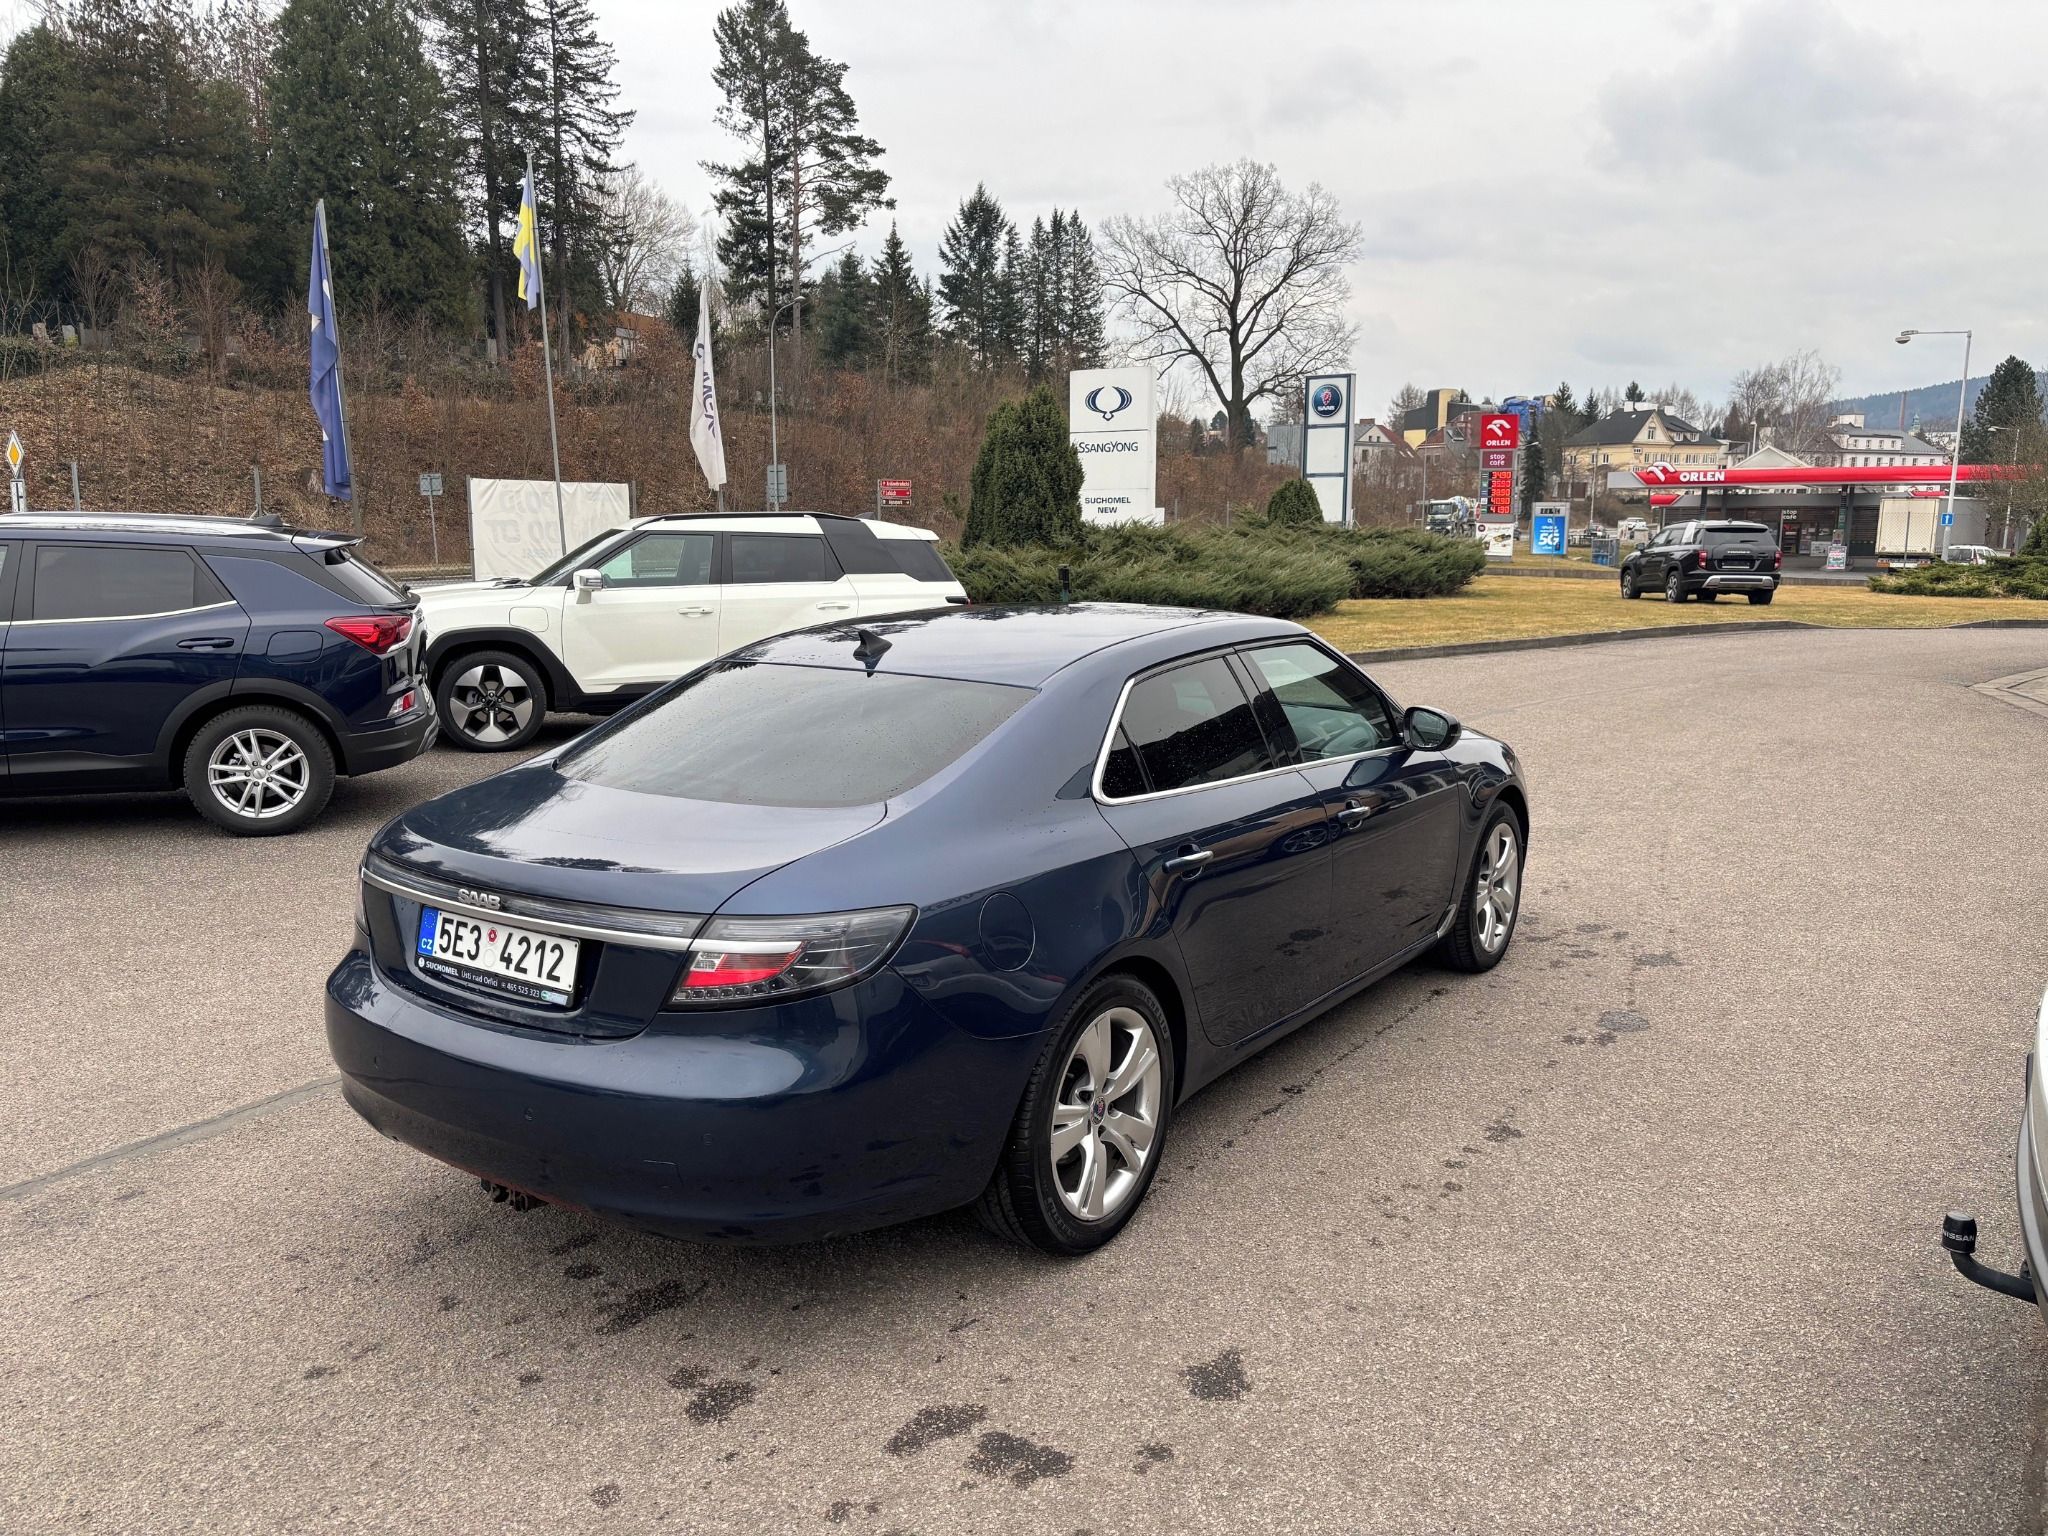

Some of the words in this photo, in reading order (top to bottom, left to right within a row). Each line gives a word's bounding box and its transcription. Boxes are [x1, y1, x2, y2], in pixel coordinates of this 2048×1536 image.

[1679, 471, 1725, 482] ORLEN
[1084, 496, 1132, 504] SUCHOMEL
[1097, 506, 1118, 514] NEW
[1538, 532, 1560, 546] 5G
[457, 888, 501, 910] SAAB
[421, 937, 433, 950] CZ
[438, 916, 482, 961] 5E3
[499, 932, 564, 983] 4212
[425, 961, 459, 976] SUCHOMEL
[472, 974, 483, 983] nad
[518, 985, 529, 994] 525
[529, 988, 540, 997] 323
[1943, 1230, 1975, 1242] NISSAN
